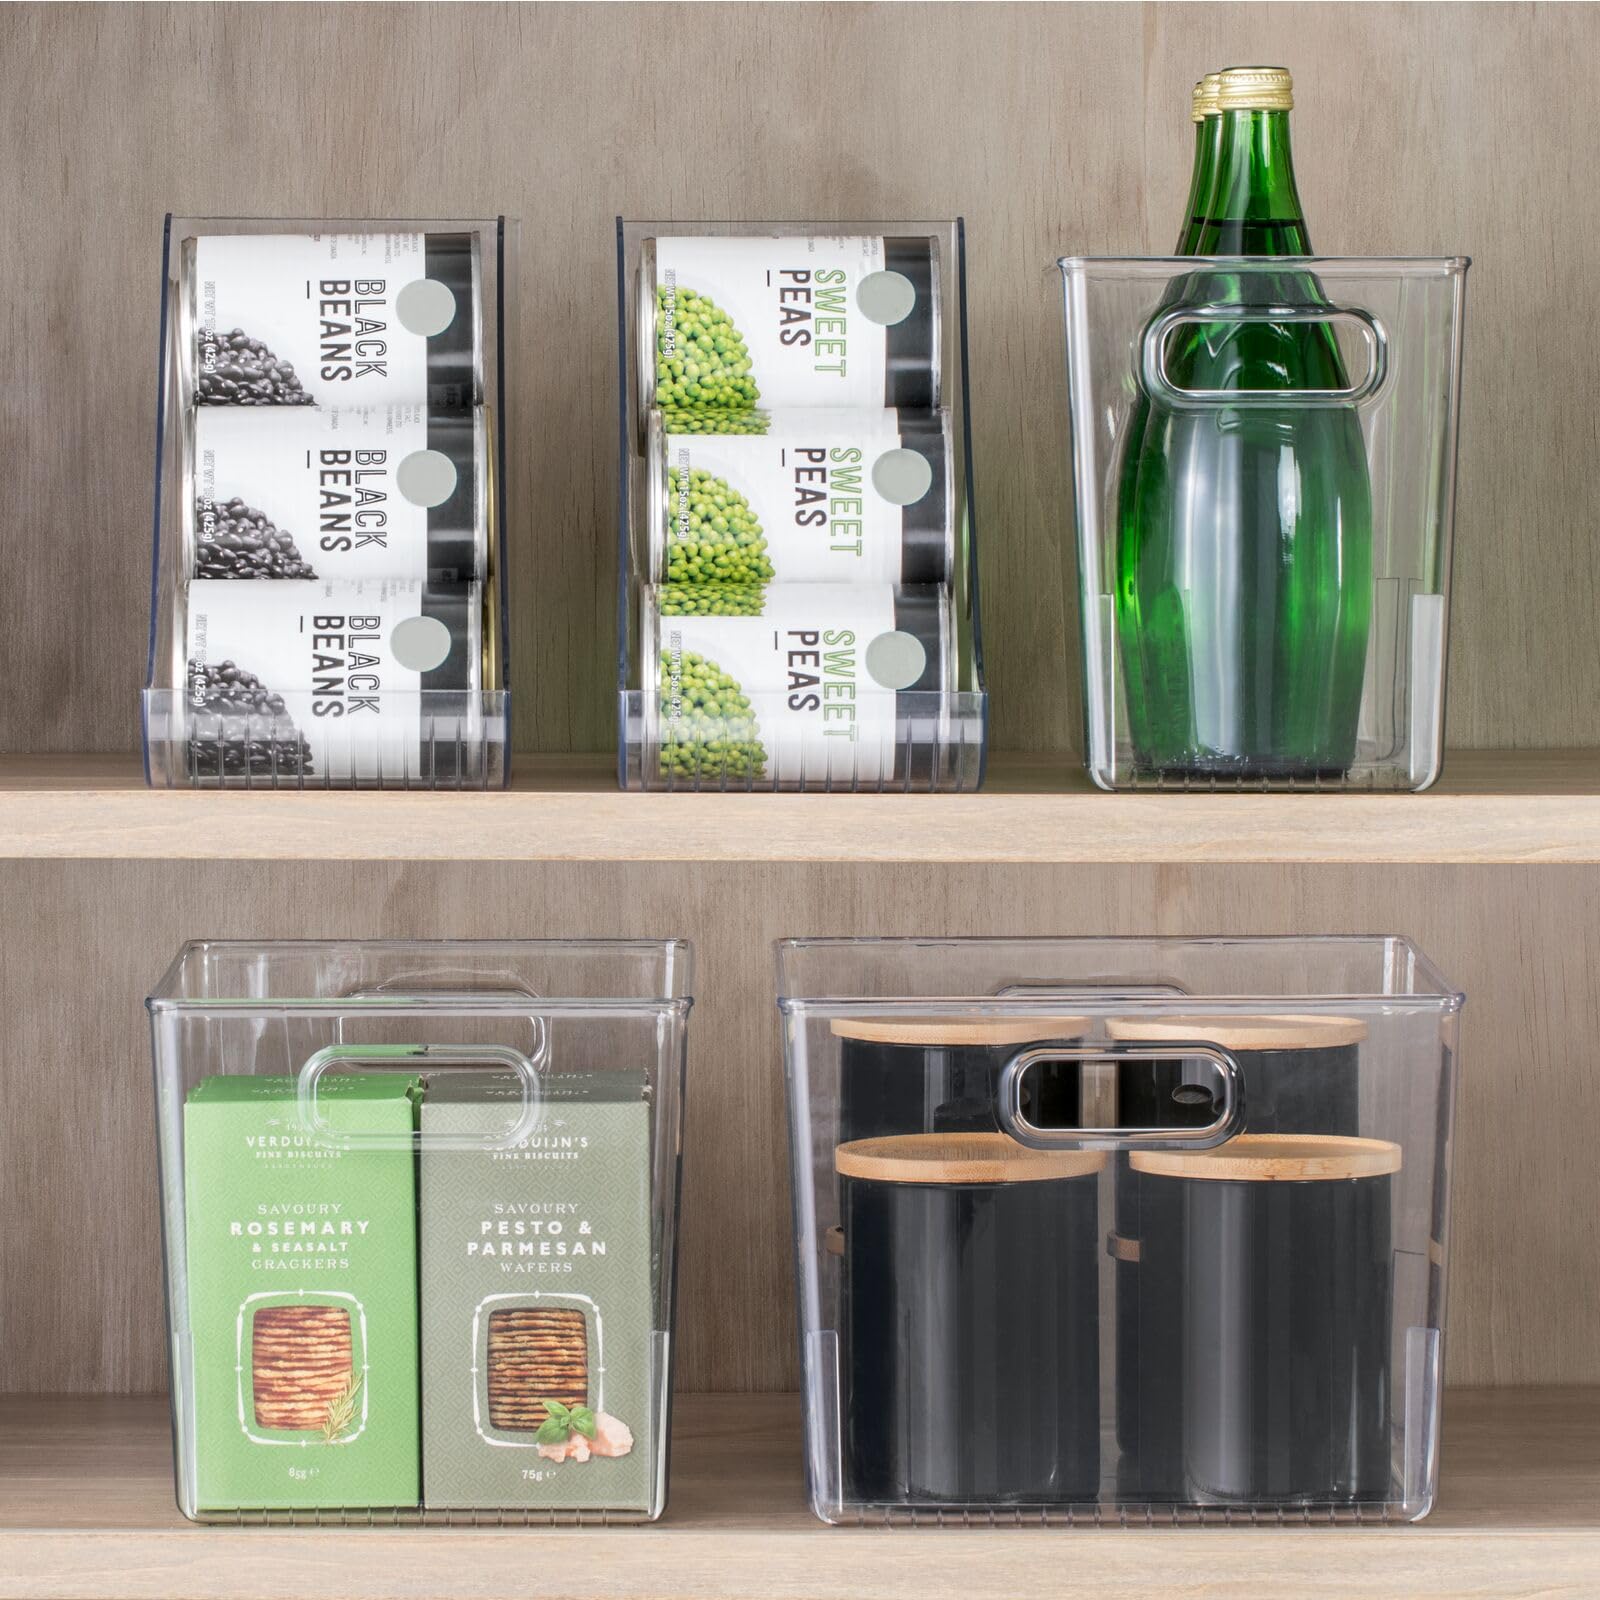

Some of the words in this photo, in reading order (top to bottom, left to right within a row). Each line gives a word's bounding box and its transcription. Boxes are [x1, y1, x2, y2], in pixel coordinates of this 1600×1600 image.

[665, 286, 676, 300] WT
[779, 269, 812, 346] PEAS
[319, 280, 352, 382] BEANS
[354, 279, 387, 378] BLACK
[814, 269, 847, 377] SWEET
[663, 329, 676, 358] (425g)
[203, 343, 217, 374] (425g)
[679, 467, 690, 482] WT
[794, 448, 827, 527] PEAS
[320, 450, 352, 552] BEANS
[354, 450, 387, 549] BLACK
[830, 448, 862, 556] SWEET
[202, 512, 216, 542] (425g)
[677, 511, 690, 540] (425g)
[312, 615, 345, 718] BEANS
[348, 615, 380, 714] BLACK
[670, 651, 681, 666] WT
[787, 630, 820, 711] PEAS
[193, 675, 207, 707] (425g)
[823, 629, 856, 742] SWEET
[246, 1135, 350, 1150] VERDU
[482, 1136, 589, 1150] DUIJN'S
[255, 1151, 282, 1159] FINE
[287, 1151, 342, 1159] BISCUITS
[493, 1152, 519, 1160] FINE
[524, 1152, 579, 1160] BISCUITS
[258, 1203, 342, 1215] SAVOURY
[494, 1203, 578, 1214] SAVOURY
[230, 1220, 370, 1236] ROSEMARY
[481, 1220, 563, 1235] PESTO
[578, 1220, 592, 1235] &
[252, 1242, 262, 1253] &
[271, 1241, 348, 1253] SEASALT
[467, 1241, 606, 1256] PARMESAN
[251, 1258, 350, 1270] CRACKERS
[500, 1262, 573, 1273] WAFERS
[288, 1466, 307, 1481] 85g
[521, 1469, 543, 1481] 75g
